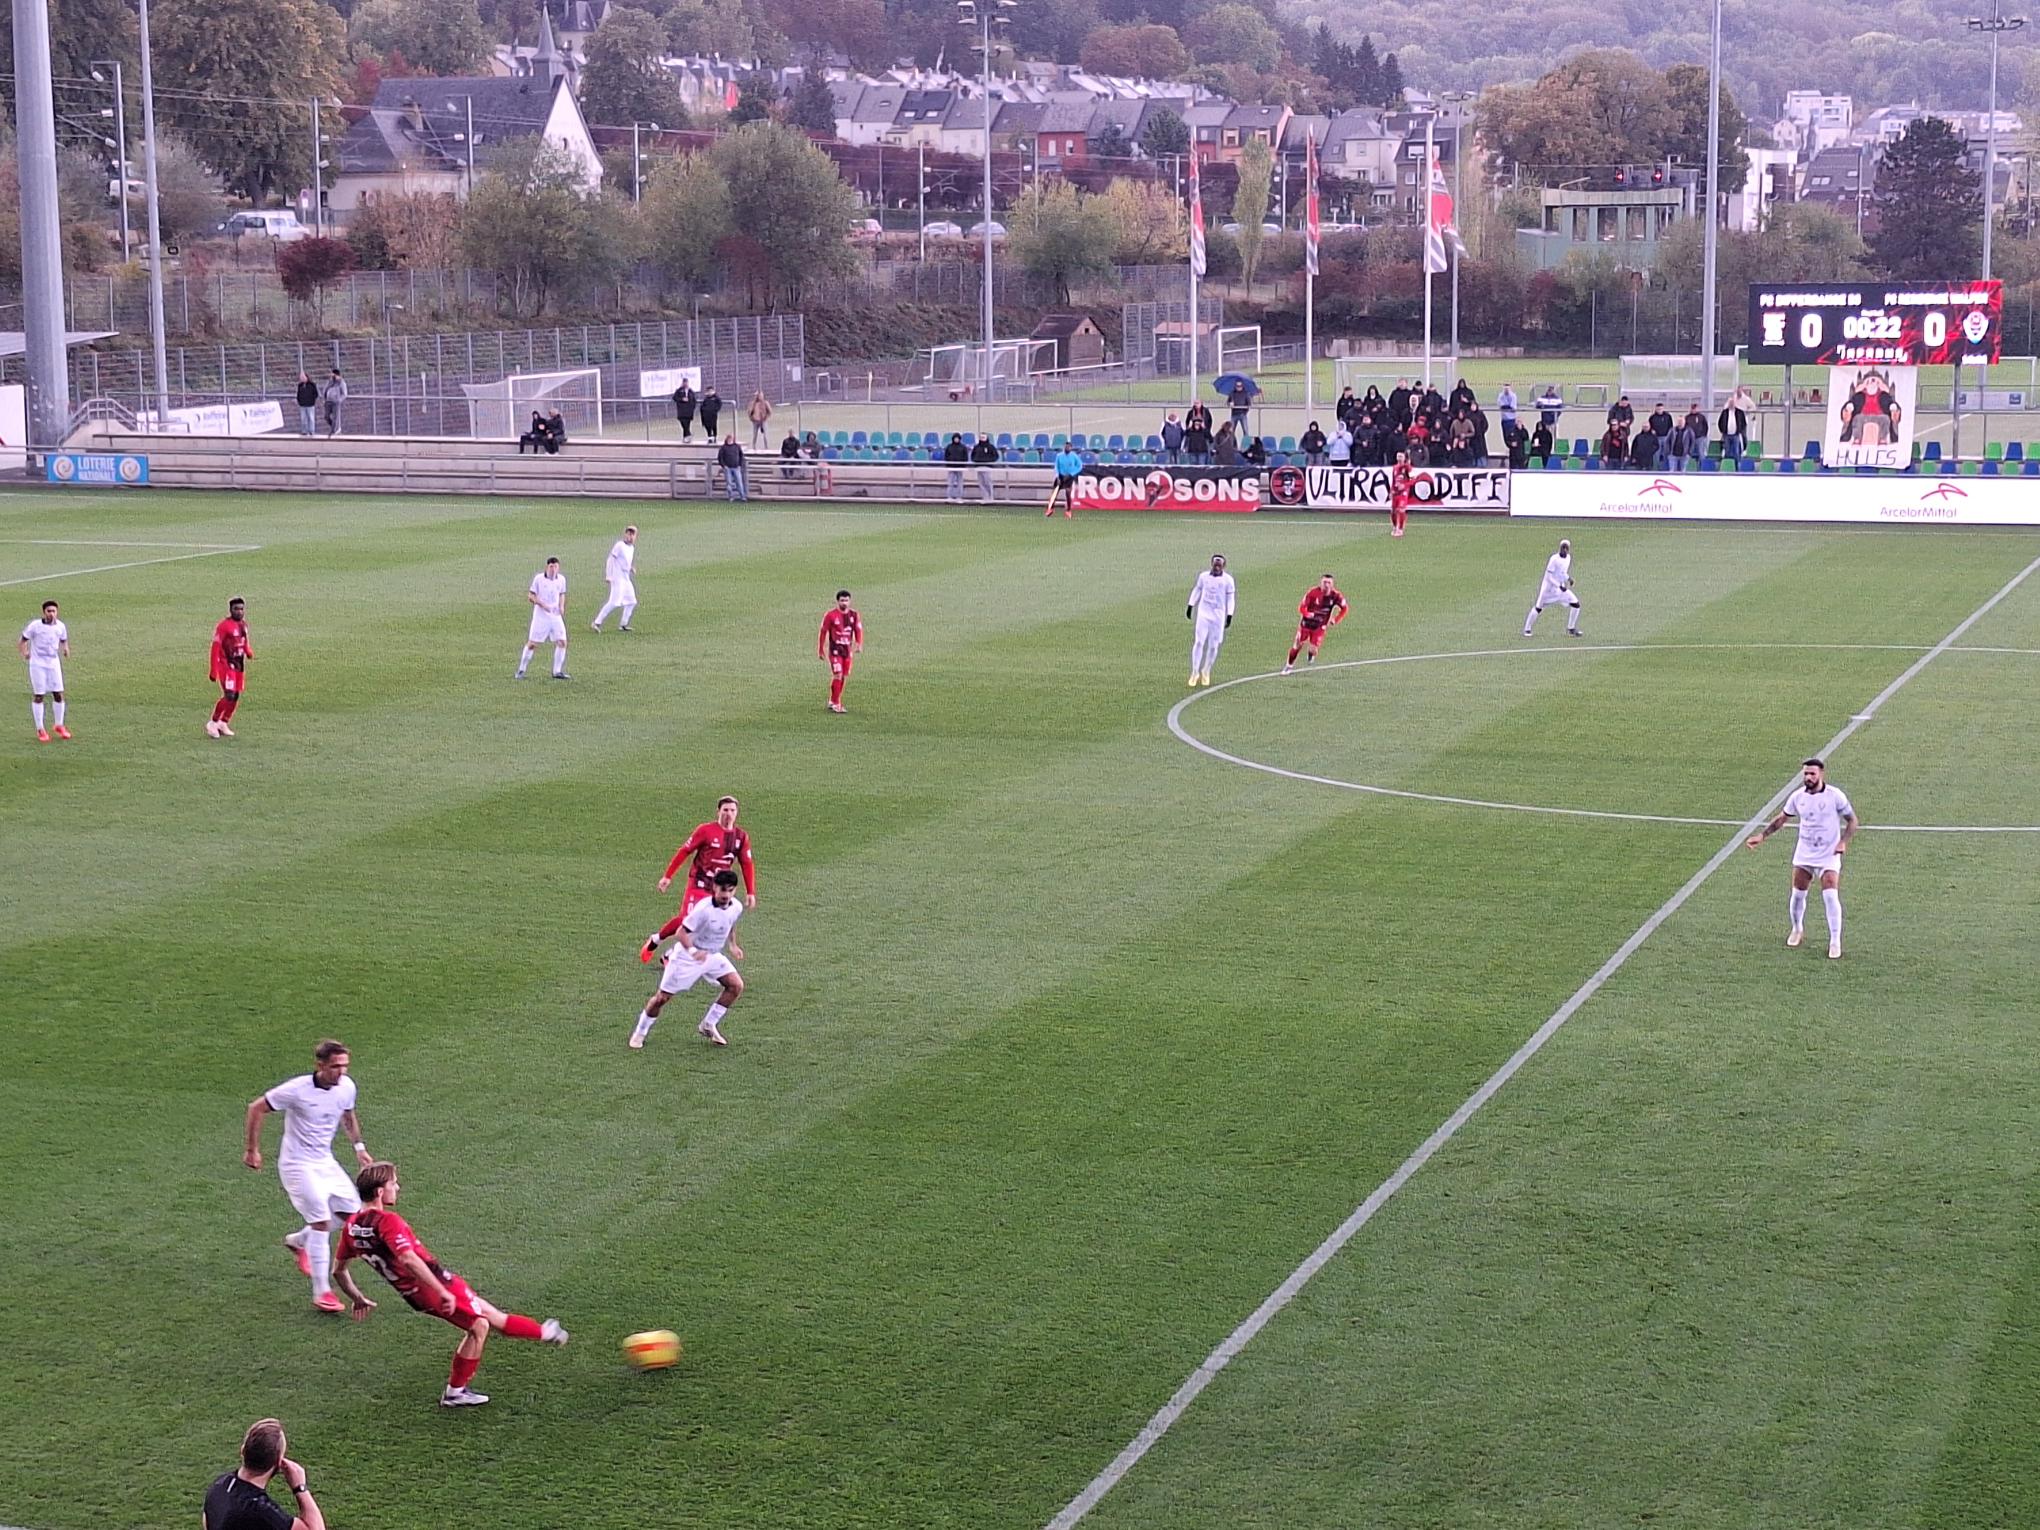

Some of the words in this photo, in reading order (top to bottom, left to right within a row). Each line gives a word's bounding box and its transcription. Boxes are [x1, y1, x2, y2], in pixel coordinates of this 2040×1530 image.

[1801, 313, 1822, 348] 0
[1844, 316, 1902, 338] 00:22
[1924, 312, 1946, 346] 0
[78, 456, 115, 470] LOTERIE
[1173, 478, 1260, 501] SONS
[1600, 502, 1672, 513] ArcelorMittal
[1880, 506, 1957, 518] ArcelorMittal
